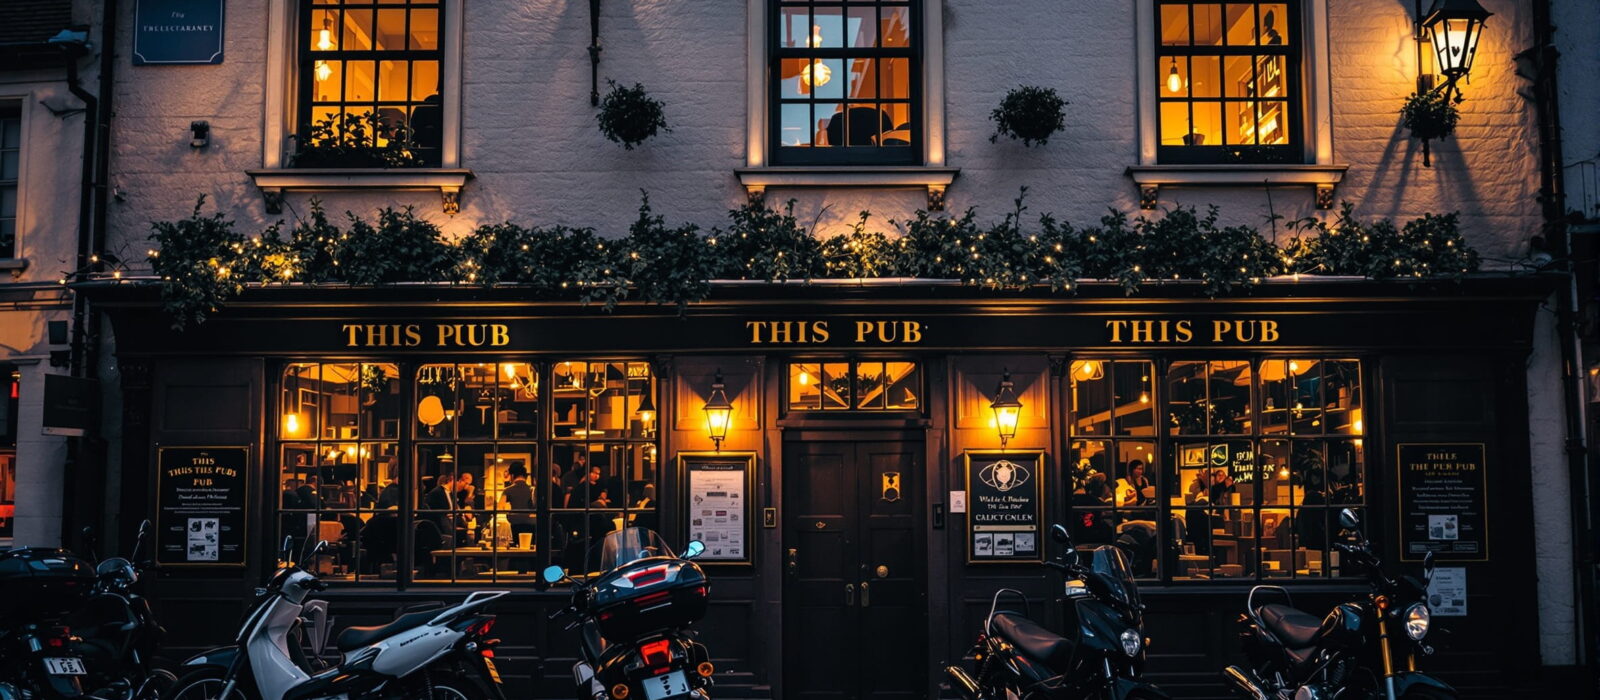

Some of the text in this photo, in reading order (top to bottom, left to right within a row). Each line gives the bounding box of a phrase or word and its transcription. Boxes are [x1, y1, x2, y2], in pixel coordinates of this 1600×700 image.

[342, 324, 421, 347] THIS
[746, 320, 922, 343] THIS PUB
[1106, 320, 1279, 342] THIS PUB
